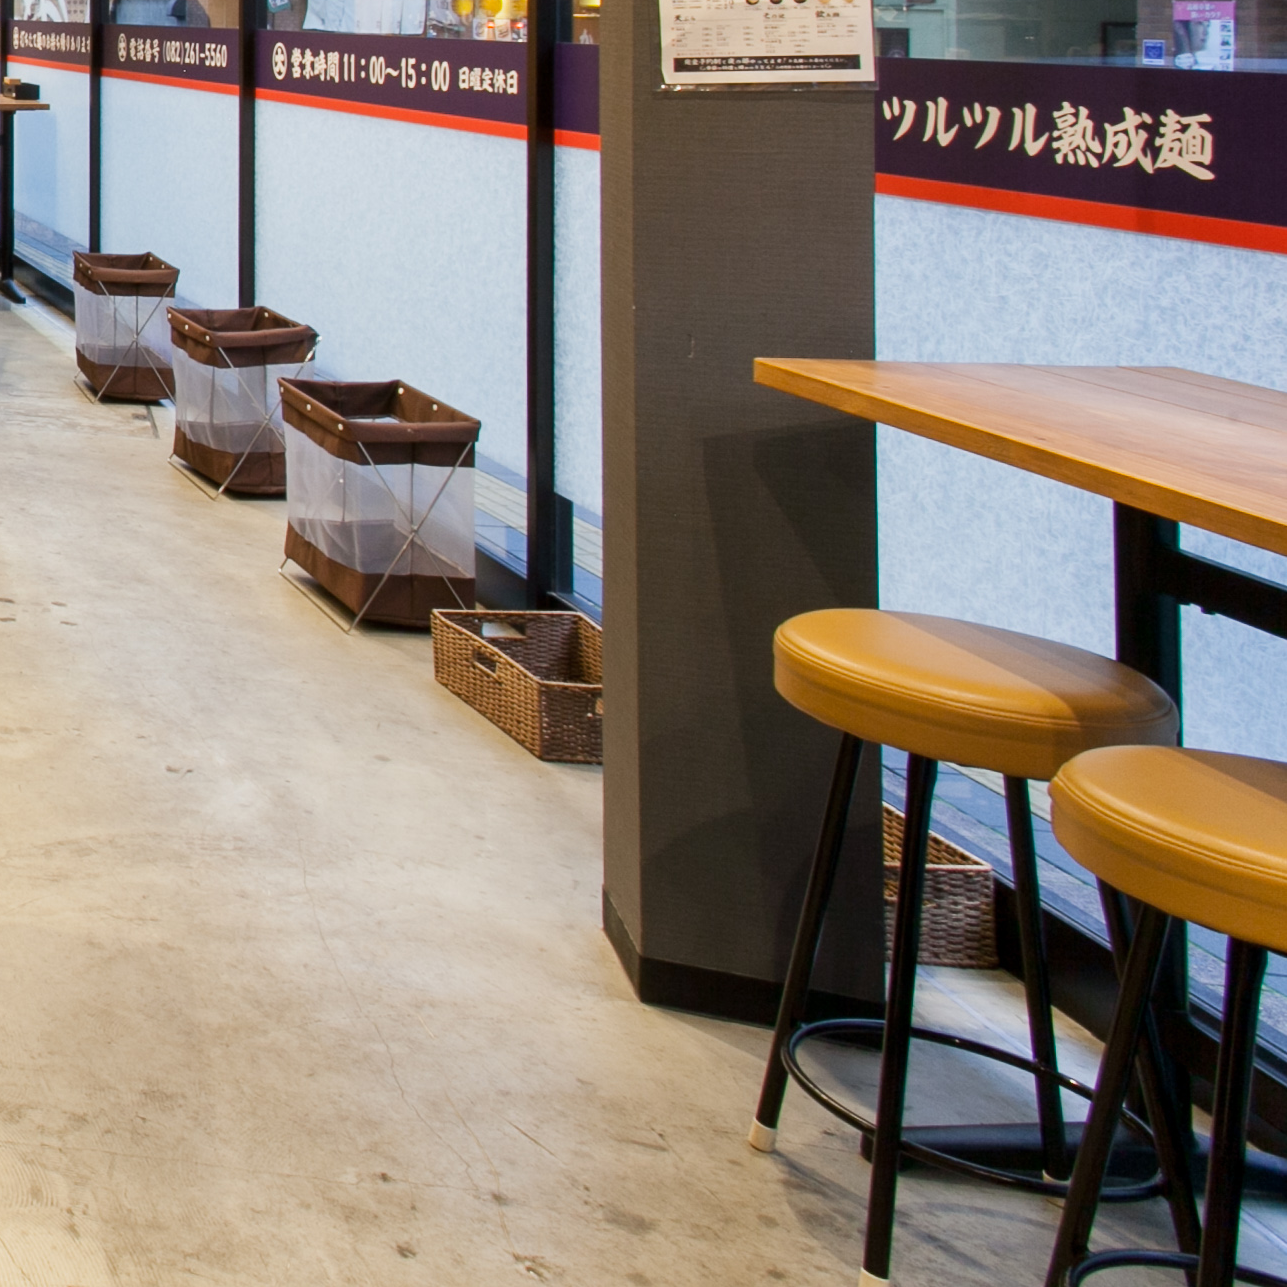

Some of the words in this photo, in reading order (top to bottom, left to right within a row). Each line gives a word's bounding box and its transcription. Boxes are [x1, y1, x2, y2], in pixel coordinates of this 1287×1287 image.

[130, 38, 159, 63] 電話番号
[163, 41, 227, 68] (082)261-5560
[291, 47, 340, 83] 営業時間
[458, 68, 518, 96] 日曜定休日
[882, 96, 1216, 181] ツルツル熟成麺
